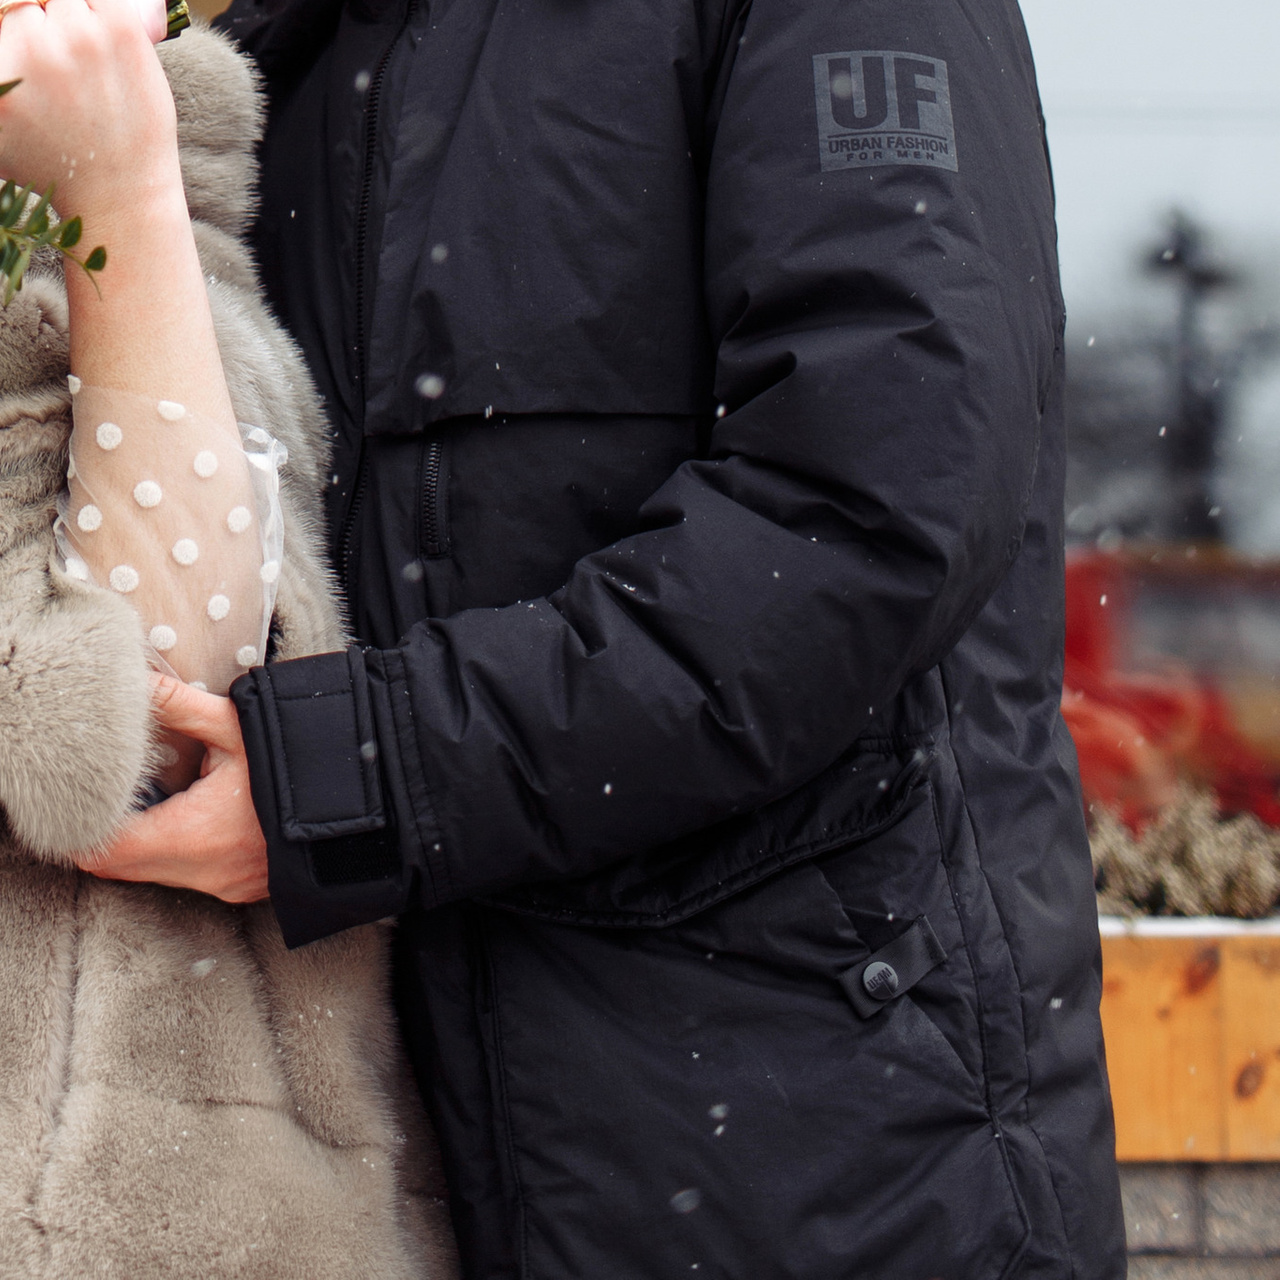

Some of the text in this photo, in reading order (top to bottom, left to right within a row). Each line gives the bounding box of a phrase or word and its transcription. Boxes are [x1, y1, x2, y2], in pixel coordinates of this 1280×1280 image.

[827, 56, 937, 129] UF
[828, 136, 949, 155] URBAN FASHION
[846, 150, 935, 162] FOR MEN
